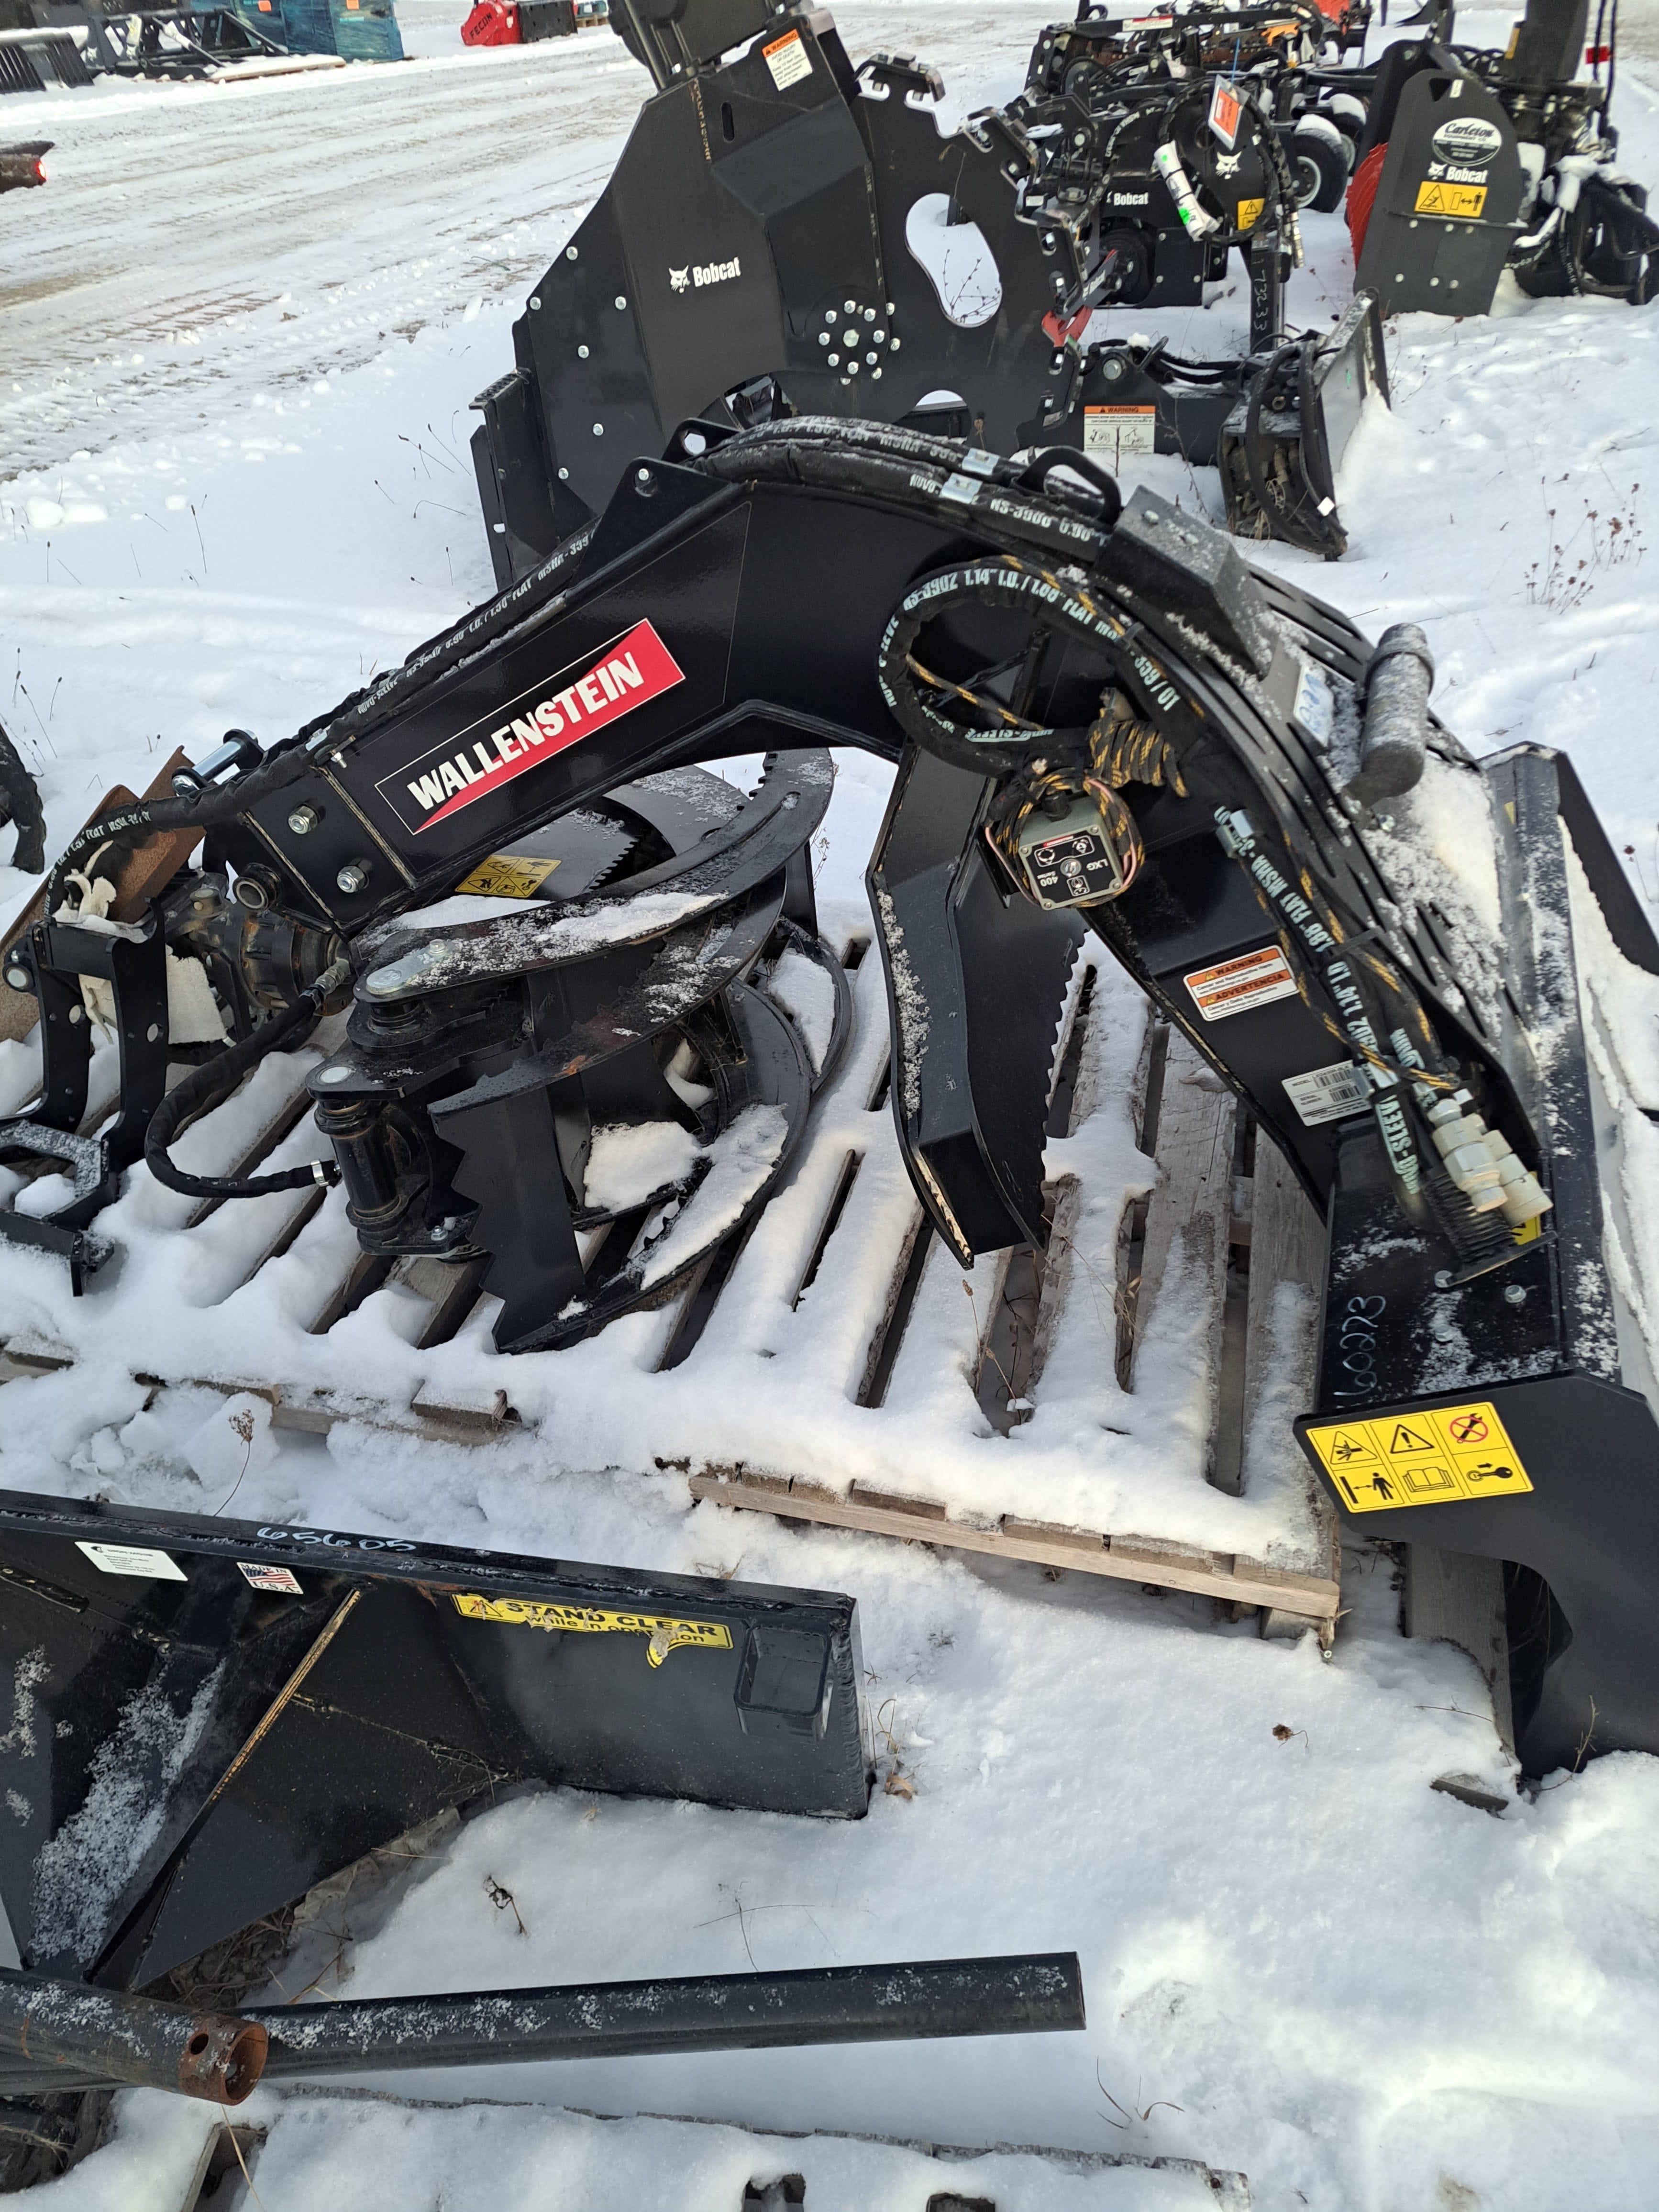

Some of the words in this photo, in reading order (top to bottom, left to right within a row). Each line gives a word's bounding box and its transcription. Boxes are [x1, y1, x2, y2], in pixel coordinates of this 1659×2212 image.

[469, 12, 493, 40] FECON
[771, 32, 797, 51] WARNING
[1444, 122, 1495, 138] Carleton
[1445, 166, 1488, 184] Bobcat
[1113, 192, 1149, 206] Bobcat
[692, 256, 741, 288] Bobcat
[408, 652, 644, 810] WALLENSTEIN
[1086, 858, 1109, 871] LXG
[1250, 853, 1289, 899] MSHA
[1040, 876, 1059, 887] 400
[1279, 891, 1314, 925] FLAT
[1216, 955, 1263, 975] WARNING
[1216, 973, 1284, 1000] ADVERTENCIA
[1333, 1295, 1386, 1396] 60273
[256, 1526, 417, 1552] 65605
[240, 1563, 273, 1573] MADE
[252, 1581, 300, 1593] U.S.A.
[505, 1602, 606, 1623] STAND
[616, 1615, 719, 1637] CLEAR
